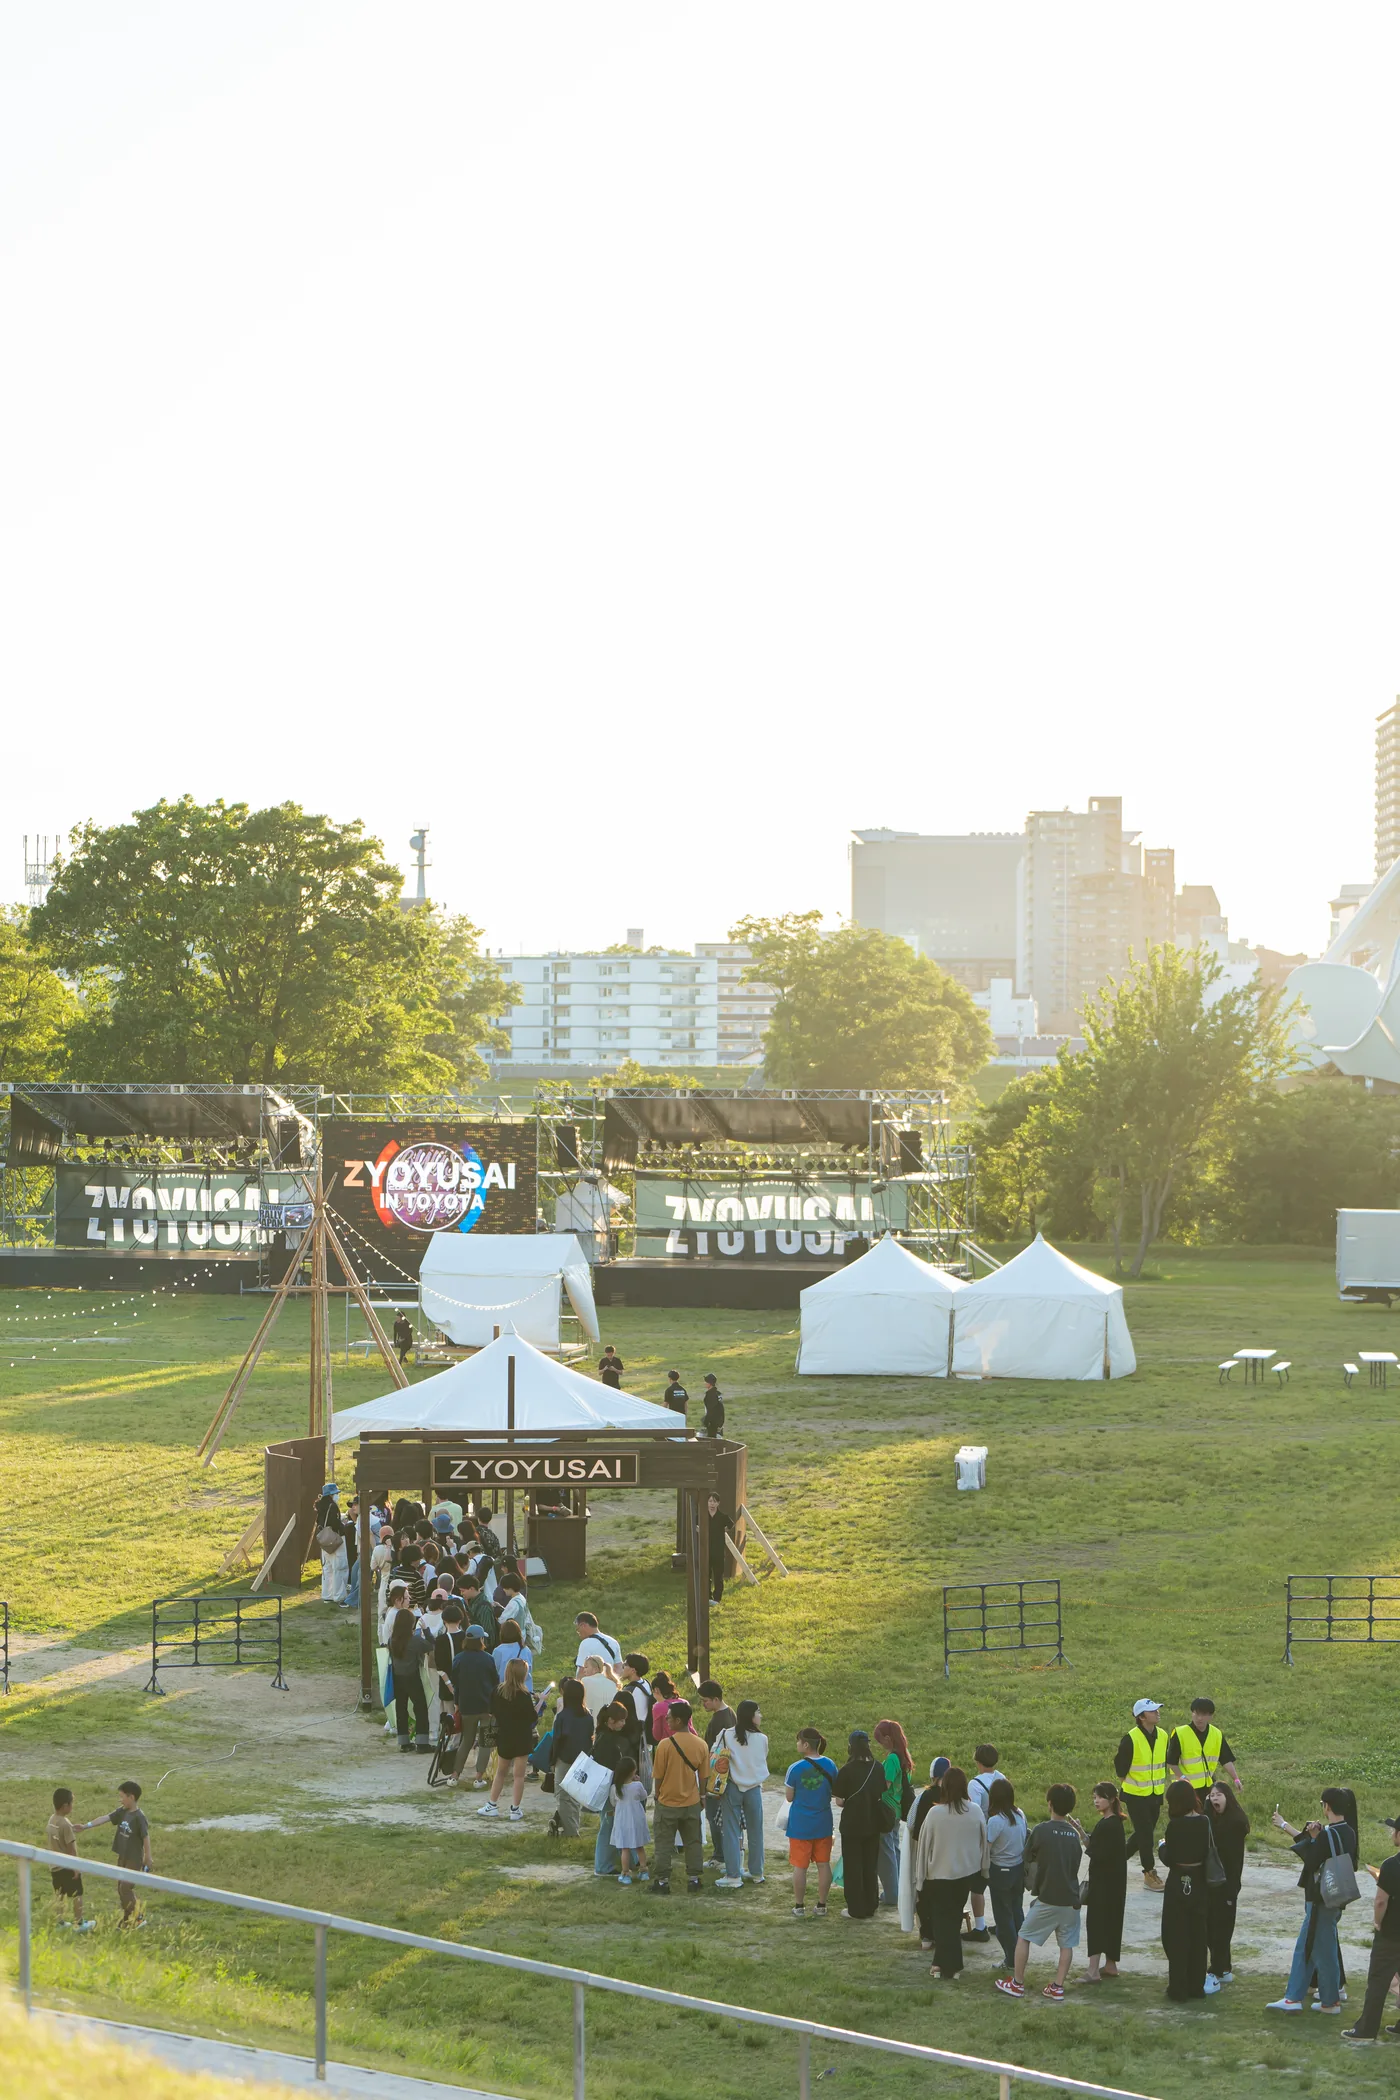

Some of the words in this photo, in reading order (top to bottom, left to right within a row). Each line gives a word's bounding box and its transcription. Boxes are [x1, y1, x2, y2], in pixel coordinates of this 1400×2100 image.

[343, 1160, 516, 1190] ZYOYUSAI
[380, 1193, 399, 1209] IN
[404, 1193, 485, 1210] TOYOTA
[259, 1210, 283, 1219] RALLY
[450, 1459, 622, 1479] ZYOYUSAI
